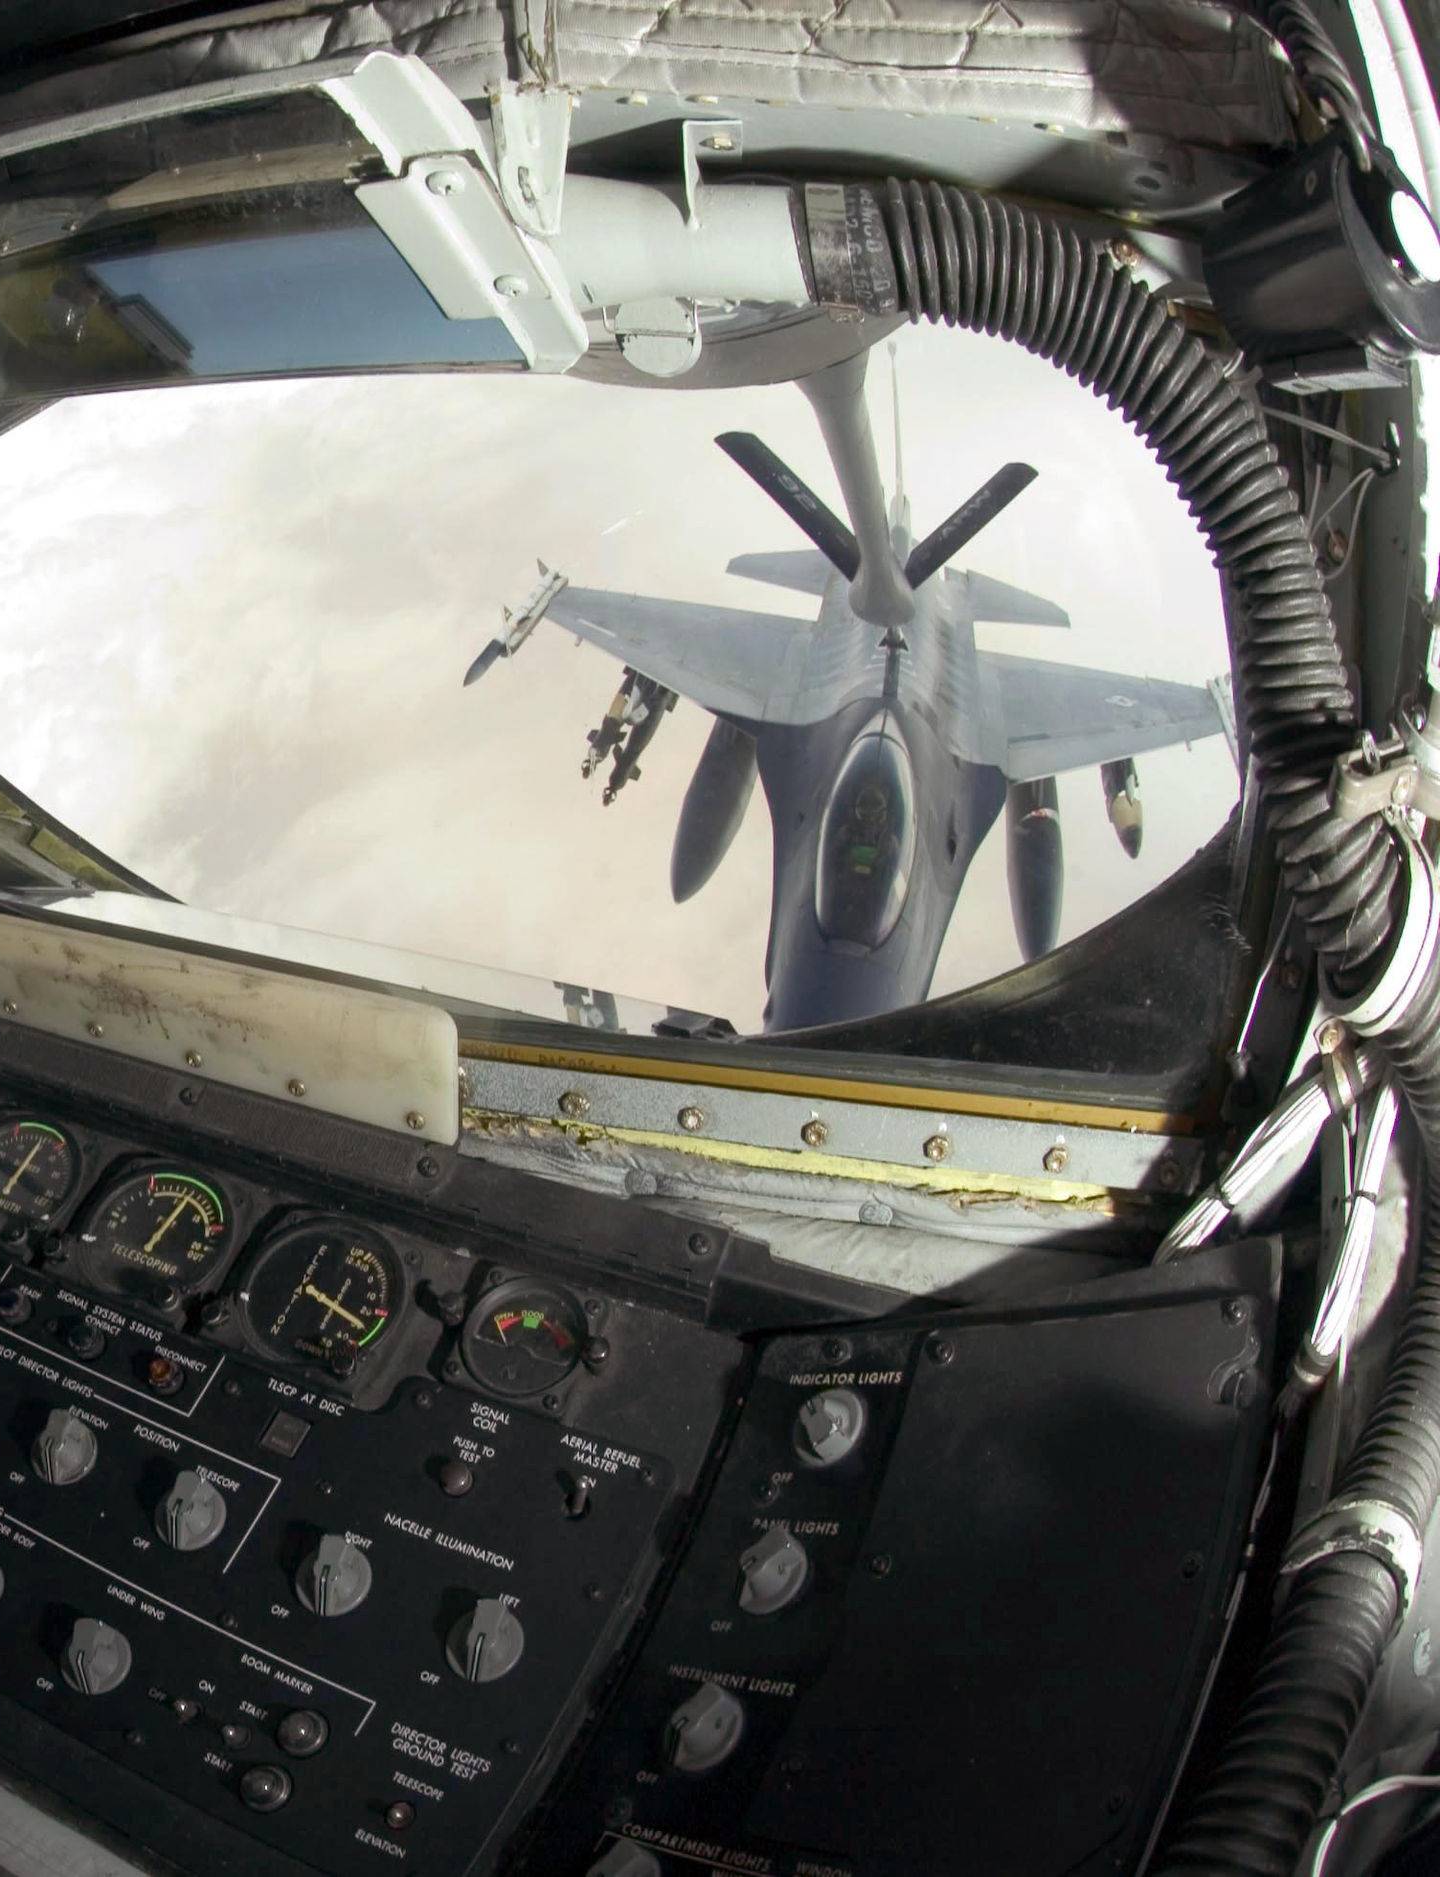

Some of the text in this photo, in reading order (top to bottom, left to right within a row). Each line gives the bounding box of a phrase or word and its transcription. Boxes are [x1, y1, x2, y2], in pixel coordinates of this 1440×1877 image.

[112, 1243, 179, 1277] TELESCOPING
[187, 1250, 206, 1264] OUT
[270, 1244, 328, 1336] ELEVATION
[57, 1289, 164, 1343] SIGNAL SYSTEM STATUS
[84, 1315, 123, 1337] CONTACT
[154, 1345, 208, 1374] DISCONNECT
[18, 1355, 60, 1384] DIRECTOR
[62, 1376, 95, 1399] LIGHTS
[789, 1370, 905, 1386] INDICATOR LIGHTS
[267, 1377, 346, 1417] TLSCP AT DISC
[68, 1404, 110, 1431] ELEVATION
[469, 1401, 511, 1427] SIGNAL
[472, 1415, 498, 1434] COIL
[132, 1424, 180, 1452] POSITION
[452, 1434, 497, 1459] PUSH TO
[459, 1449, 482, 1465] TEST
[560, 1433, 642, 1470] AERIAL REFUEL
[572, 1451, 620, 1475] MASTER
[9, 1471, 26, 1483] OFF
[195, 1465, 242, 1493] TELESCOPE
[771, 1472, 795, 1484] OFF
[794, 1519, 840, 1536] LIGHTS
[13, 1532, 37, 1550] BODY
[133, 1536, 151, 1550] OFF
[383, 1512, 515, 1572] NACELLE ILLUMINATION
[107, 1584, 167, 1622] UNDER WING
[271, 1604, 292, 1619] OFF
[498, 1592, 522, 1610] LEFT
[711, 1619, 735, 1633] OFF
[35, 1676, 55, 1692] OFF
[240, 1653, 315, 1696] BOOM MARKER
[419, 1670, 442, 1687] OFF
[667, 1664, 798, 1698] INSTRUMENT LIGHTS
[197, 1679, 217, 1696] ON
[239, 1700, 270, 1721] START
[391, 1722, 493, 1774] DIRECTOR LIGHTS
[392, 1738, 479, 1783] GROUND TEST
[203, 1751, 235, 1774] START
[392, 1770, 446, 1801] TELESCOPE
[636, 1770, 660, 1785] OFF
[354, 1828, 408, 1860] ELEVATION
[621, 1822, 774, 1873] COMPARTMENT LIGHTS
